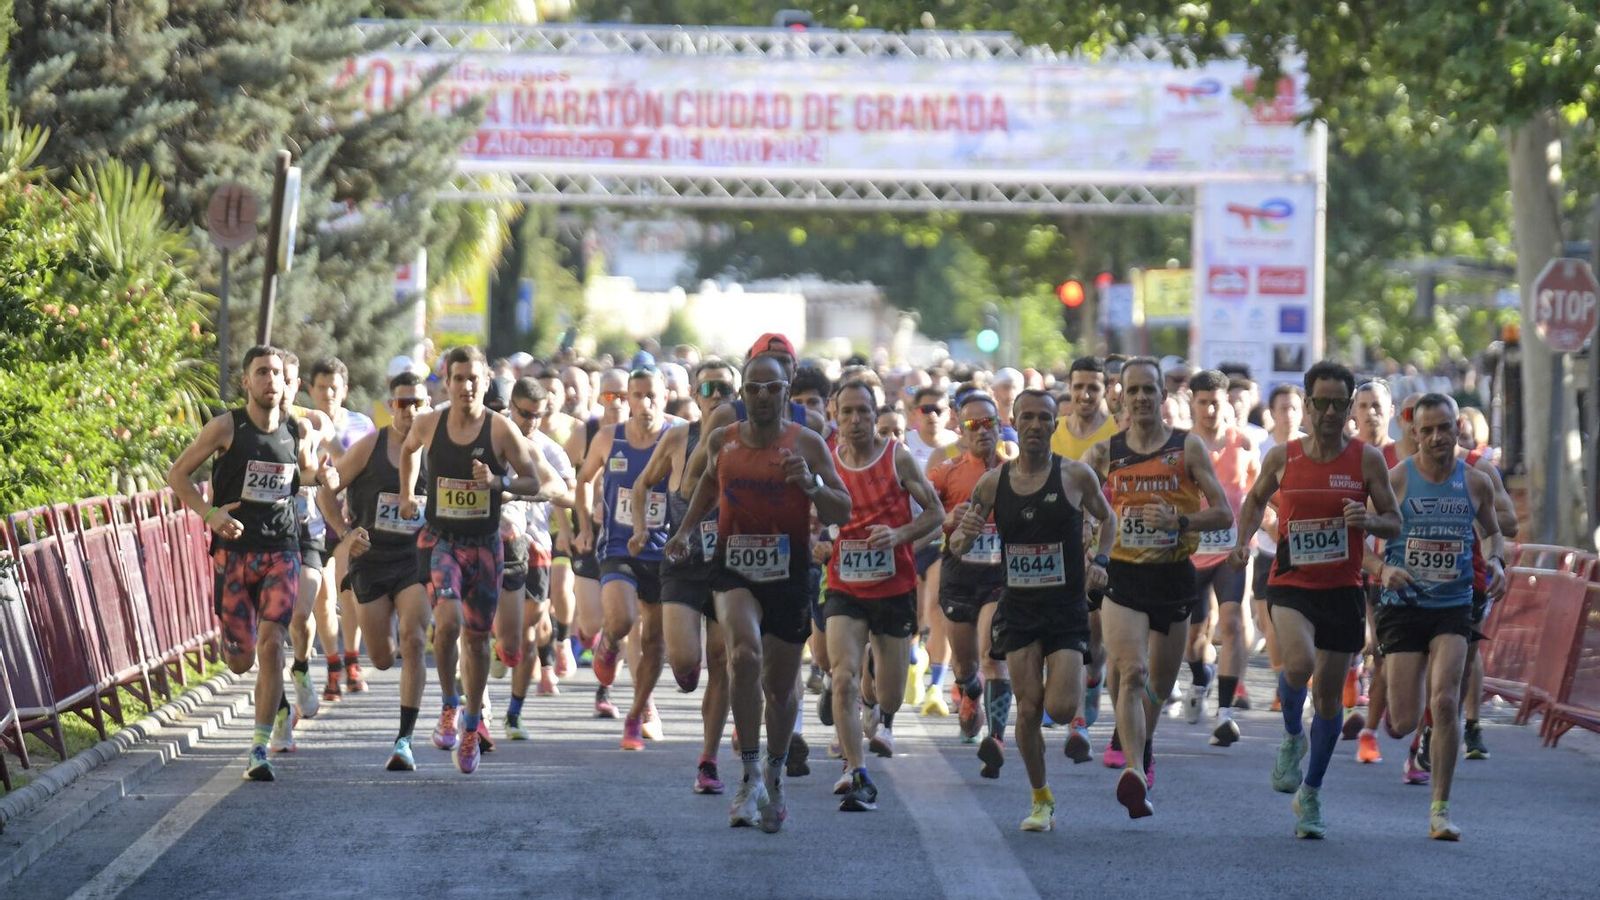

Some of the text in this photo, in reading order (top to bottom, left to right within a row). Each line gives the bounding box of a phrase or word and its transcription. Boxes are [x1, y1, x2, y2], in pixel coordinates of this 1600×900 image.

[512, 81, 664, 128] MARATÓN
[672, 89, 793, 130] CIUDAD
[802, 93, 842, 132] DE
[853, 93, 1009, 134] GRANADA
[482, 131, 614, 157] Alhambra
[1539, 289, 1597, 322] STOP
[247, 473, 287, 490] 2467
[1329, 480, 1362, 489] VAMPIROS
[445, 491, 477, 506] 160
[620, 500, 658, 517] 15
[1122, 518, 1167, 535] 35
[1200, 530, 1231, 544] 333
[1292, 530, 1340, 550] 1504
[729, 548, 779, 567] 5091
[843, 551, 886, 568] 4712
[1009, 555, 1055, 573] 4644
[1407, 551, 1456, 569] 5399
